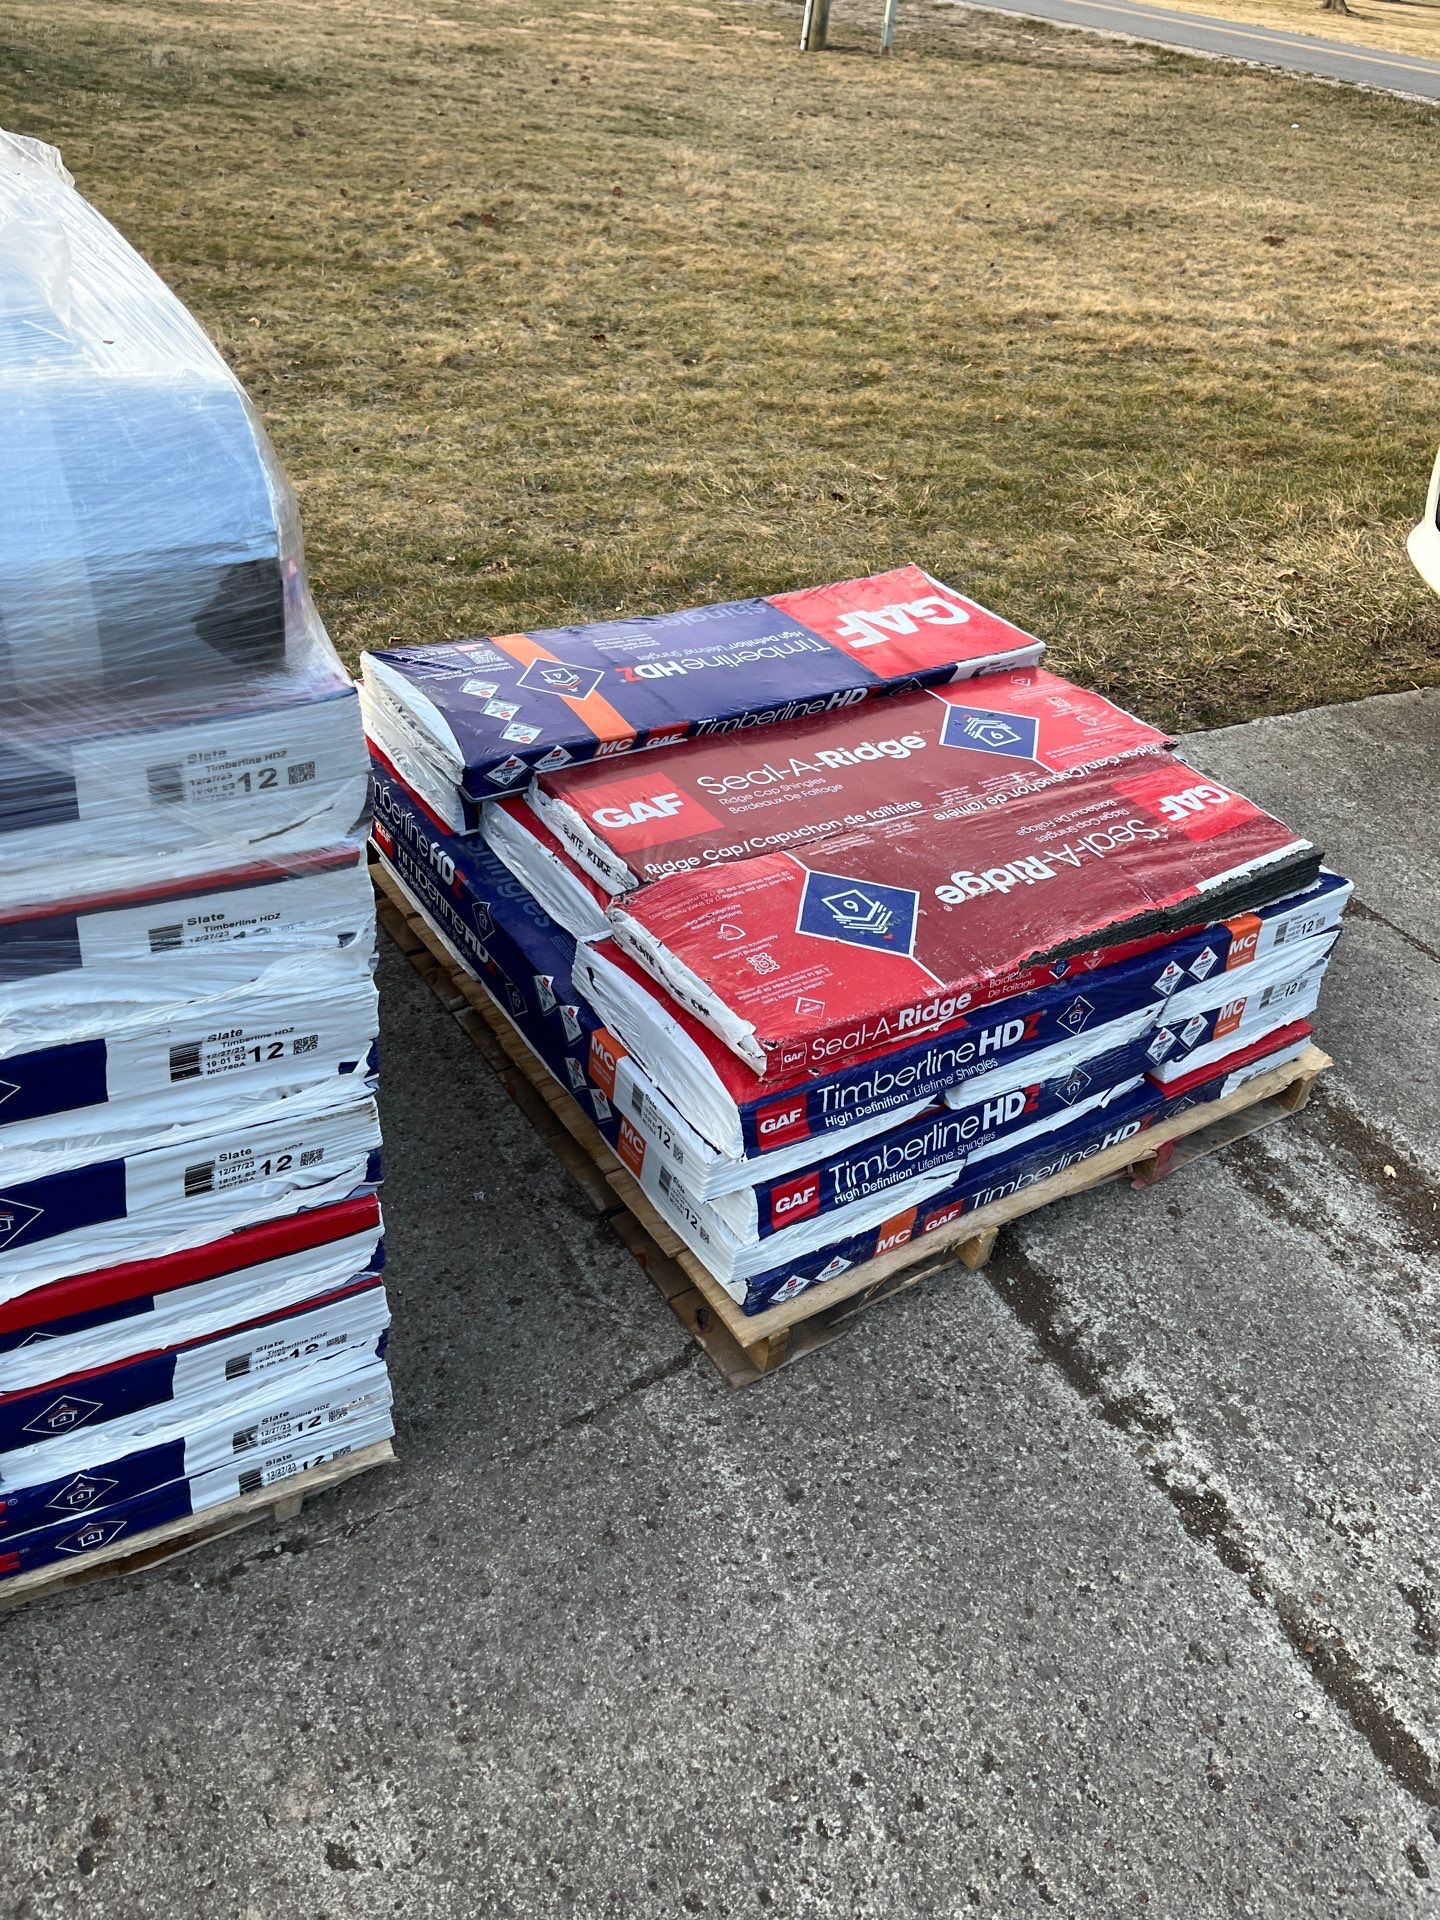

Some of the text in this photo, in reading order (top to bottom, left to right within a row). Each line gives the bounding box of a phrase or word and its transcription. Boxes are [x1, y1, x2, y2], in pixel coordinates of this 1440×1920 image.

[838, 597, 970, 648] GAF
[597, 739, 633, 757] MC
[645, 732, 687, 749] GAF
[698, 698, 826, 737] Timberline
[187, 750, 227, 764] Slate
[206, 757, 262, 772] Timberline
[696, 735, 927, 795] Seal-A-Ridge
[237, 767, 278, 792] 12
[719, 778, 827, 805] Ridge Cap Shingles
[592, 792, 685, 828] GAF
[1158, 784, 1231, 822] GAF
[374, 781, 429, 858] mberline
[1100, 808, 1130, 822] Ridge
[645, 855, 701, 876] Ridge
[702, 818, 843, 862] Cap/Capuchon
[846, 813, 867, 826] de
[934, 819, 1160, 904] Seal-A-Ridge
[187, 913, 226, 926] Slate
[204, 918, 257, 933] Timberline
[260, 912, 282, 923] HDZ
[1301, 920, 1315, 935] 12
[189, 930, 230, 943] 12/27/23
[1229, 932, 1258, 956] MC
[1285, 982, 1298, 998] 12
[1219, 996, 1246, 1021] MC
[206, 1029, 243, 1043] Slate
[221, 1027, 295, 1049] Timberline HDZ
[784, 991, 972, 1065] GAF Seal-A-Ridge
[206, 1045, 245, 1060] 12/27/23
[235, 1053, 247, 1062] S2
[248, 1041, 284, 1062] 12
[591, 1034, 616, 1072] MC
[760, 1010, 1041, 1135] GAF Timberline HDZ
[825, 1057, 999, 1128] High Definition Lifetime Shingles
[620, 1121, 644, 1154] MC
[657, 1125, 671, 1150] 12
[219, 1148, 252, 1162] Slate
[775, 1083, 1040, 1214] GAF Timberline HDZ
[219, 1161, 255, 1176] 12/27/23
[260, 1154, 293, 1176] 12
[834, 1130, 996, 1205] High Definition Lifetime Shingles
[875, 1228, 911, 1255] MC
[924, 1208, 959, 1233] GAF
[972, 1143, 1100, 1210] Timberline
[684, 1207, 698, 1230] 12
[256, 1340, 285, 1353] Slate
[310, 1331, 328, 1341] HDZ
[290, 1343, 319, 1359] 12
[262, 1411, 290, 1426] Slate
[314, 1403, 331, 1413] HDZ
[261, 1423, 291, 1437] 12/27/23
[294, 1415, 322, 1433] 12
[265, 1454, 292, 1467] Slate
[267, 1462, 297, 1478] 12/27/23
[303, 1455, 326, 1471] 12
